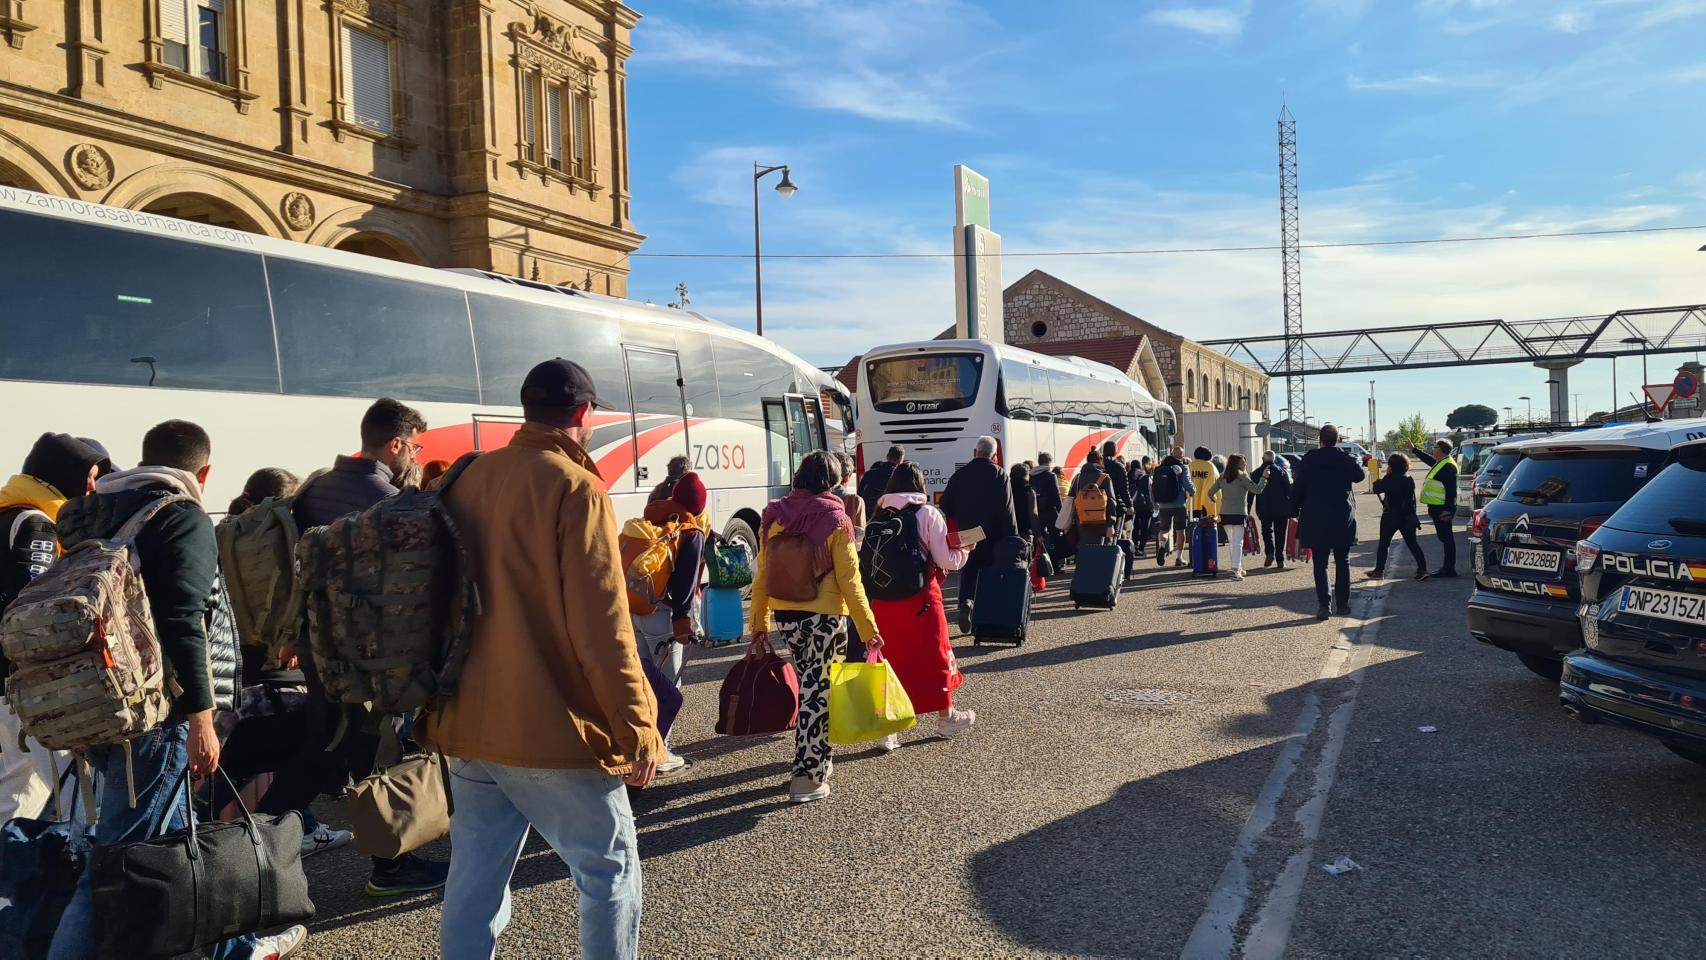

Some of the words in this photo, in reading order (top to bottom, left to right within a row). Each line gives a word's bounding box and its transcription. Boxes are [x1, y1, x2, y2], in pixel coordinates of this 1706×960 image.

[693, 444, 745, 470] zasa
[1508, 550, 1557, 568] CNP2328BB
[1627, 590, 1706, 621] CNP2315ZA
